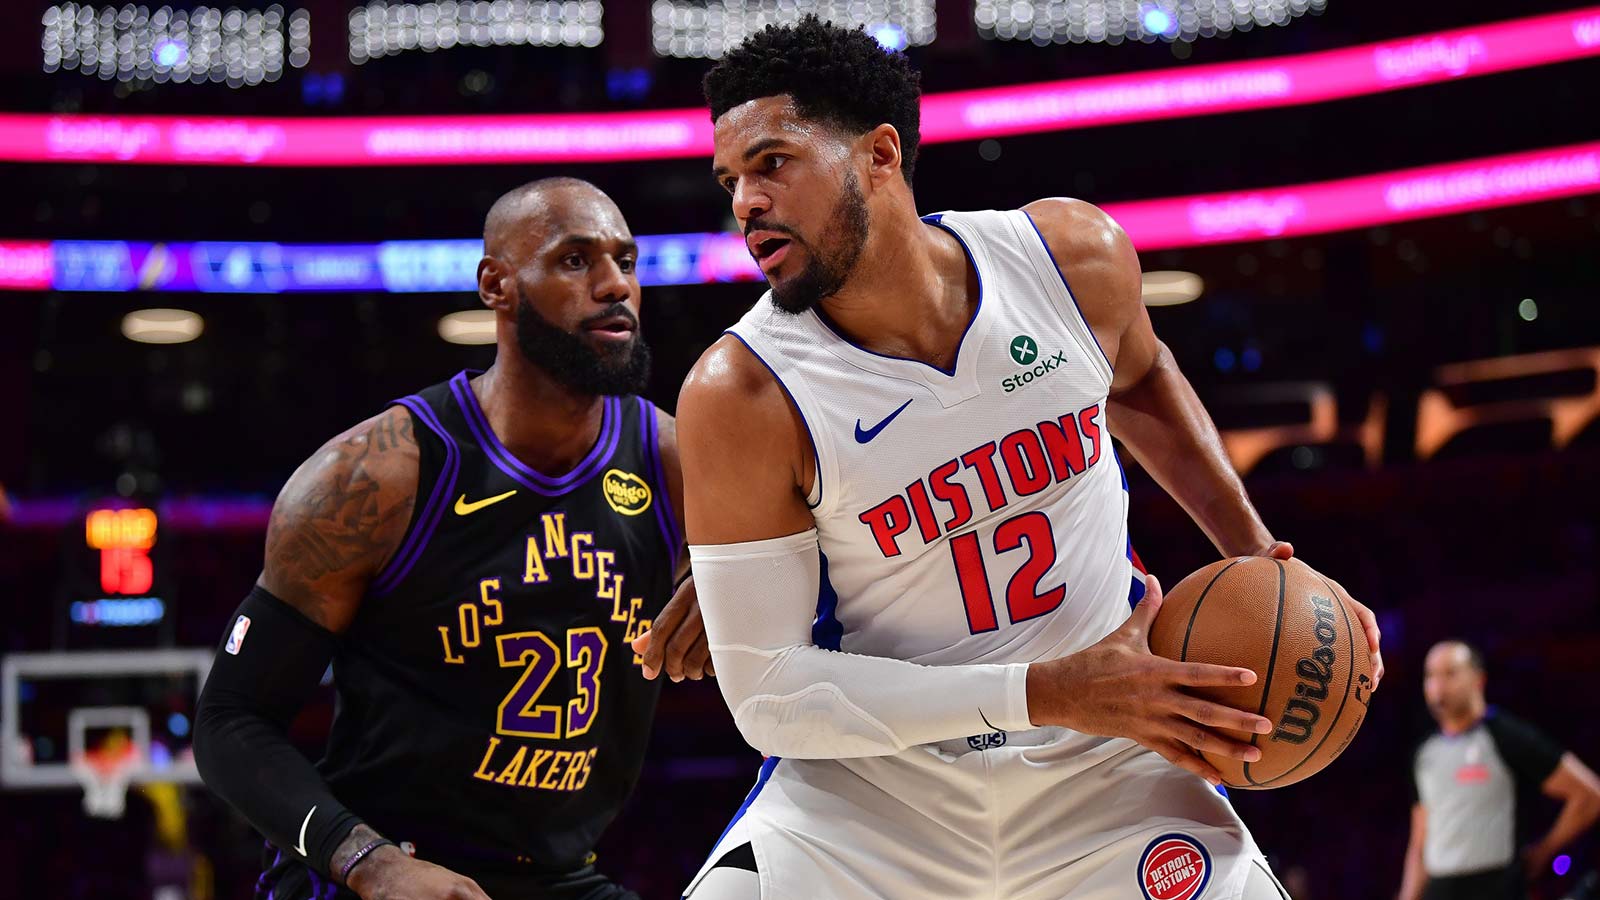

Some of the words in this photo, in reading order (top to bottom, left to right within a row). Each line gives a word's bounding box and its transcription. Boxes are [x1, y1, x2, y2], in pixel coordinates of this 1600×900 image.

[1002, 350, 1068, 393] StockX
[606, 478, 647, 504] bibigo
[858, 404, 1101, 558] PISTONS
[949, 510, 1067, 635] 12
[437, 578, 504, 665] LOS
[495, 626, 609, 740] 23
[1270, 594, 1337, 746] Wilson
[472, 736, 598, 792] LAKERS
[1149, 852, 1192, 883] DETROIT
[1154, 863, 1197, 896] PISTONS
